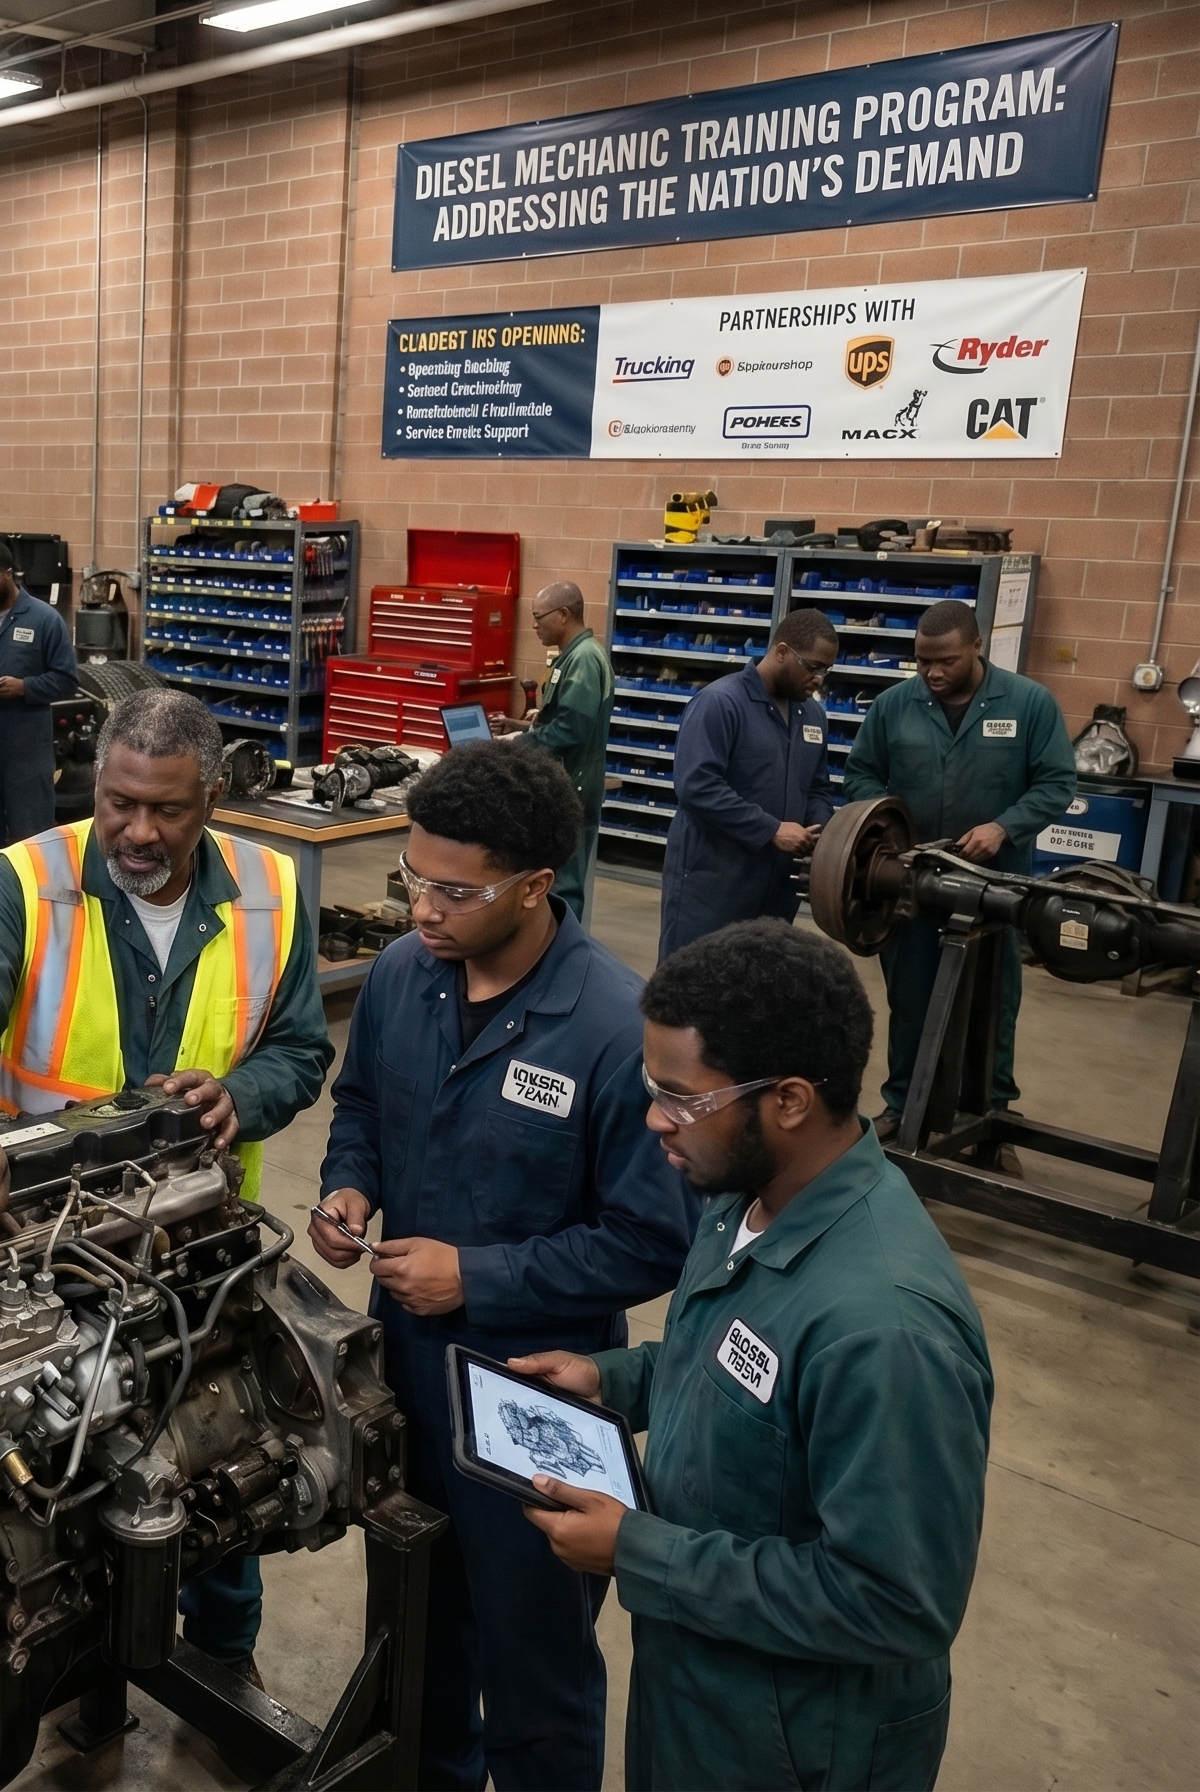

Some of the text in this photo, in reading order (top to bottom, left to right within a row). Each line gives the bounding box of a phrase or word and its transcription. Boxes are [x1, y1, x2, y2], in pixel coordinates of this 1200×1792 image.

[416, 67, 1067, 200] DIESEL MECHANIC TRAINING PROGRAM:
[433, 131, 1024, 242] ADDRESSING THE NATION'S DEMAND
[719, 298, 916, 332] PARTNERSHIPS WITH
[615, 355, 695, 378] Trucking
[957, 335, 1049, 366] Ryder
[405, 425, 444, 440] Service
[484, 423, 529, 442] Support
[966, 397, 1038, 440] CAT
